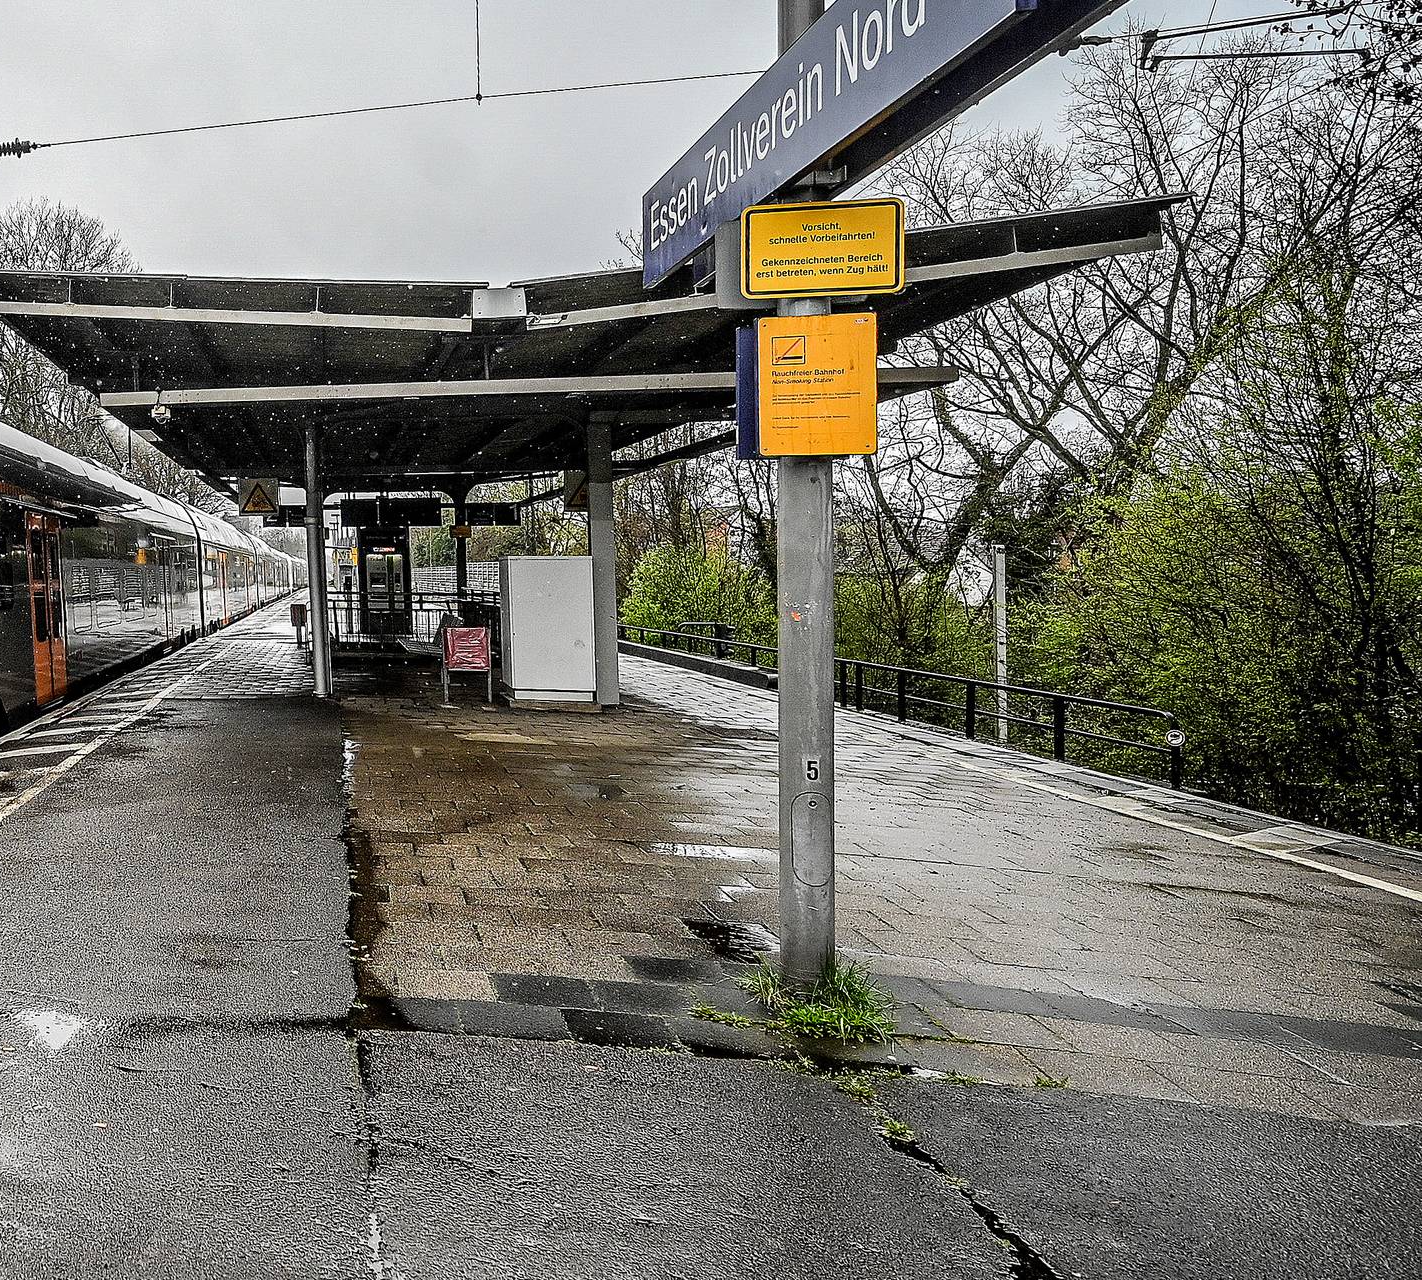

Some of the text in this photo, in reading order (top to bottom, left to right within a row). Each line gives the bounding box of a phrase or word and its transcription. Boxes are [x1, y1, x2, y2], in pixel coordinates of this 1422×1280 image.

[649, 176, 698, 252] Essen
[703, 61, 823, 207] Zollverein
[801, 222, 842, 232] Vorsicht,
[769, 232, 875, 245] schnelle Vorbeifahrten!
[761, 253, 883, 267] Gekennzeichneten Bereich
[756, 264, 889, 279] erst betreten, wenn Zug hält!
[771, 368, 845, 378] Rauchfreier Bahnhof
[813, 377, 835, 385] Station
[806, 760, 819, 781] 5
